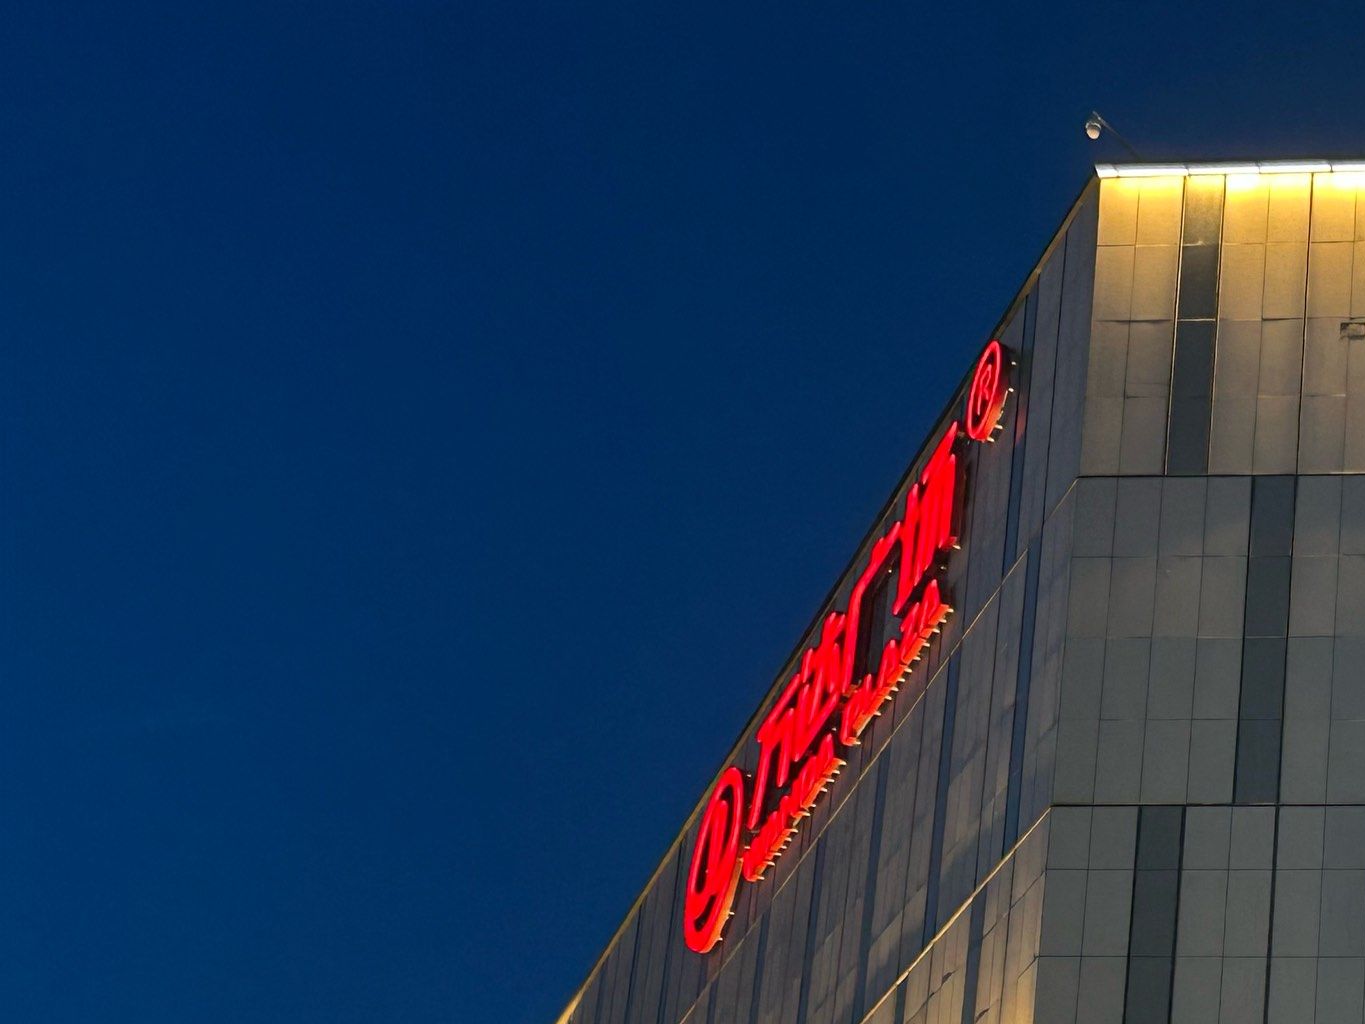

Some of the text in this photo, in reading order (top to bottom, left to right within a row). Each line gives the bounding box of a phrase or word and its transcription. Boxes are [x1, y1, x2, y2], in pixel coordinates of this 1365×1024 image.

[748, 421, 958, 829] 万达广场
[841, 578, 944, 746] PLAZA
